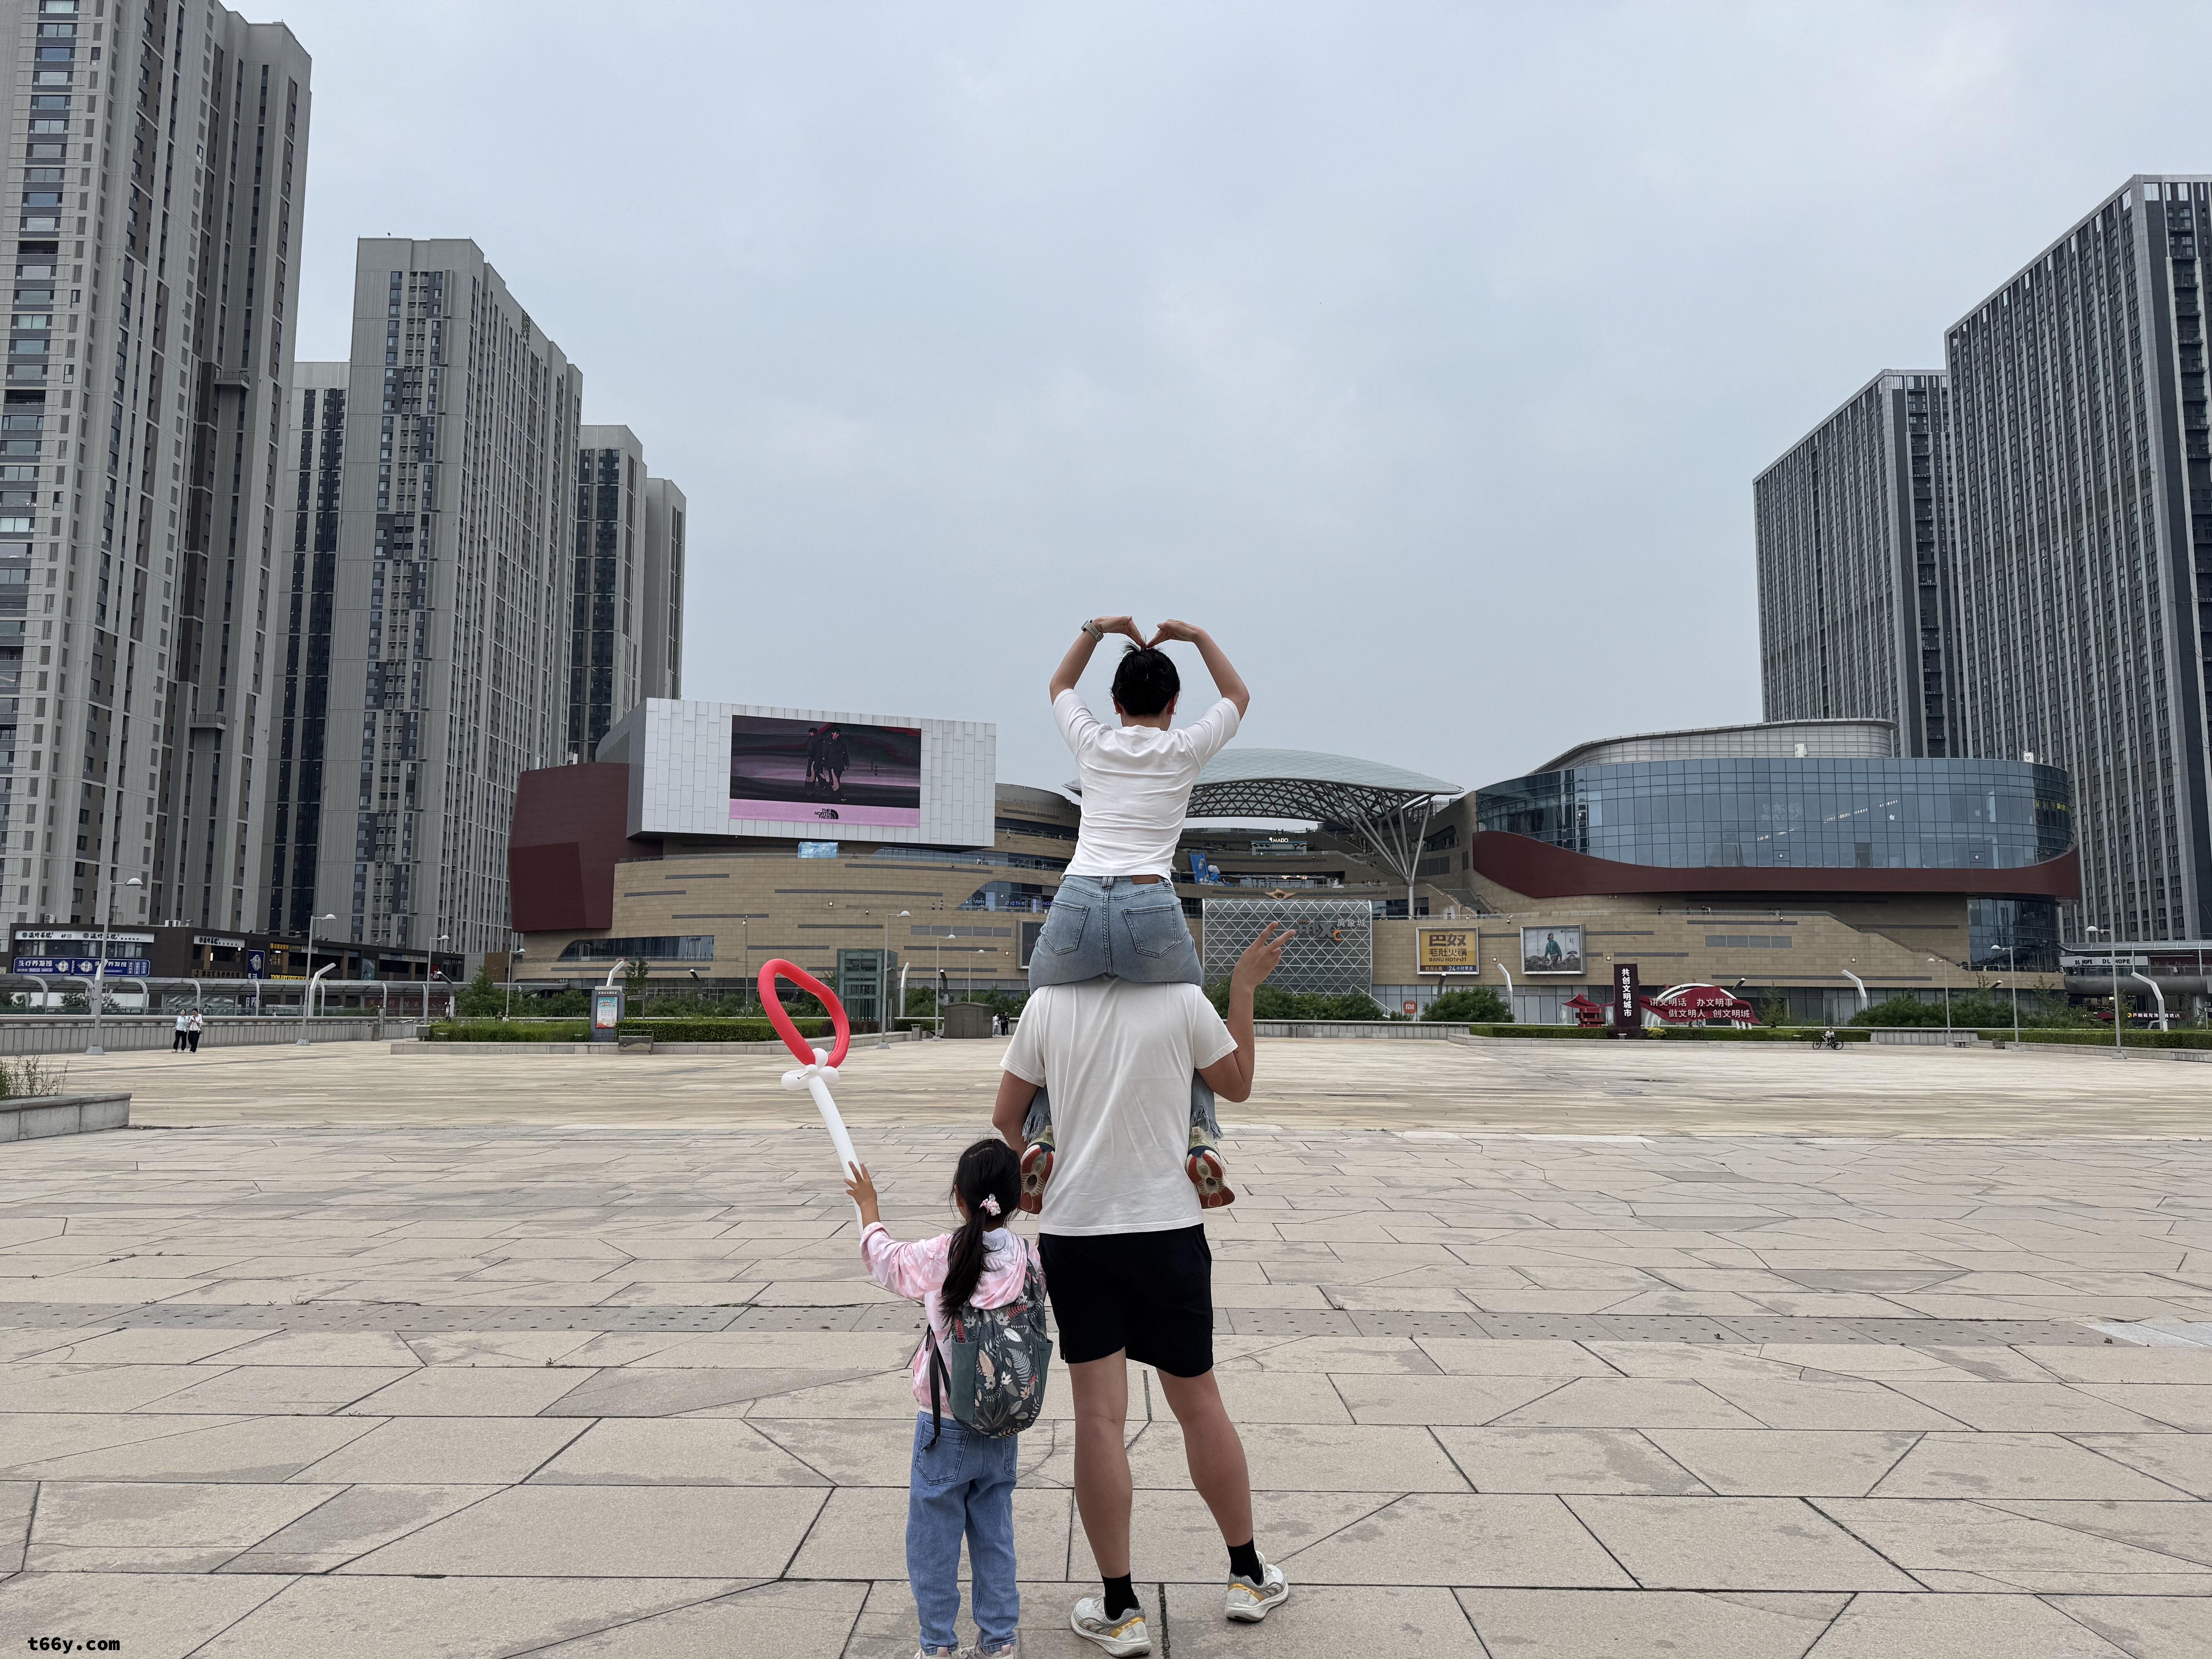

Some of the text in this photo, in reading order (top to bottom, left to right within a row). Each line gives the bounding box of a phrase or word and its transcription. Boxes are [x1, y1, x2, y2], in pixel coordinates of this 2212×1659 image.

[1337, 919, 1366, 927] 萬象城
[1429, 934, 1467, 946] 巴奴
[1429, 948, 1467, 957] 毛肚火锅
[1621, 968, 1632, 1017] 共创文明城市
[1649, 998, 1733, 1007] 讲文明话 办文明事
[1668, 1009, 1750, 1018] 做文明人 创文明城
